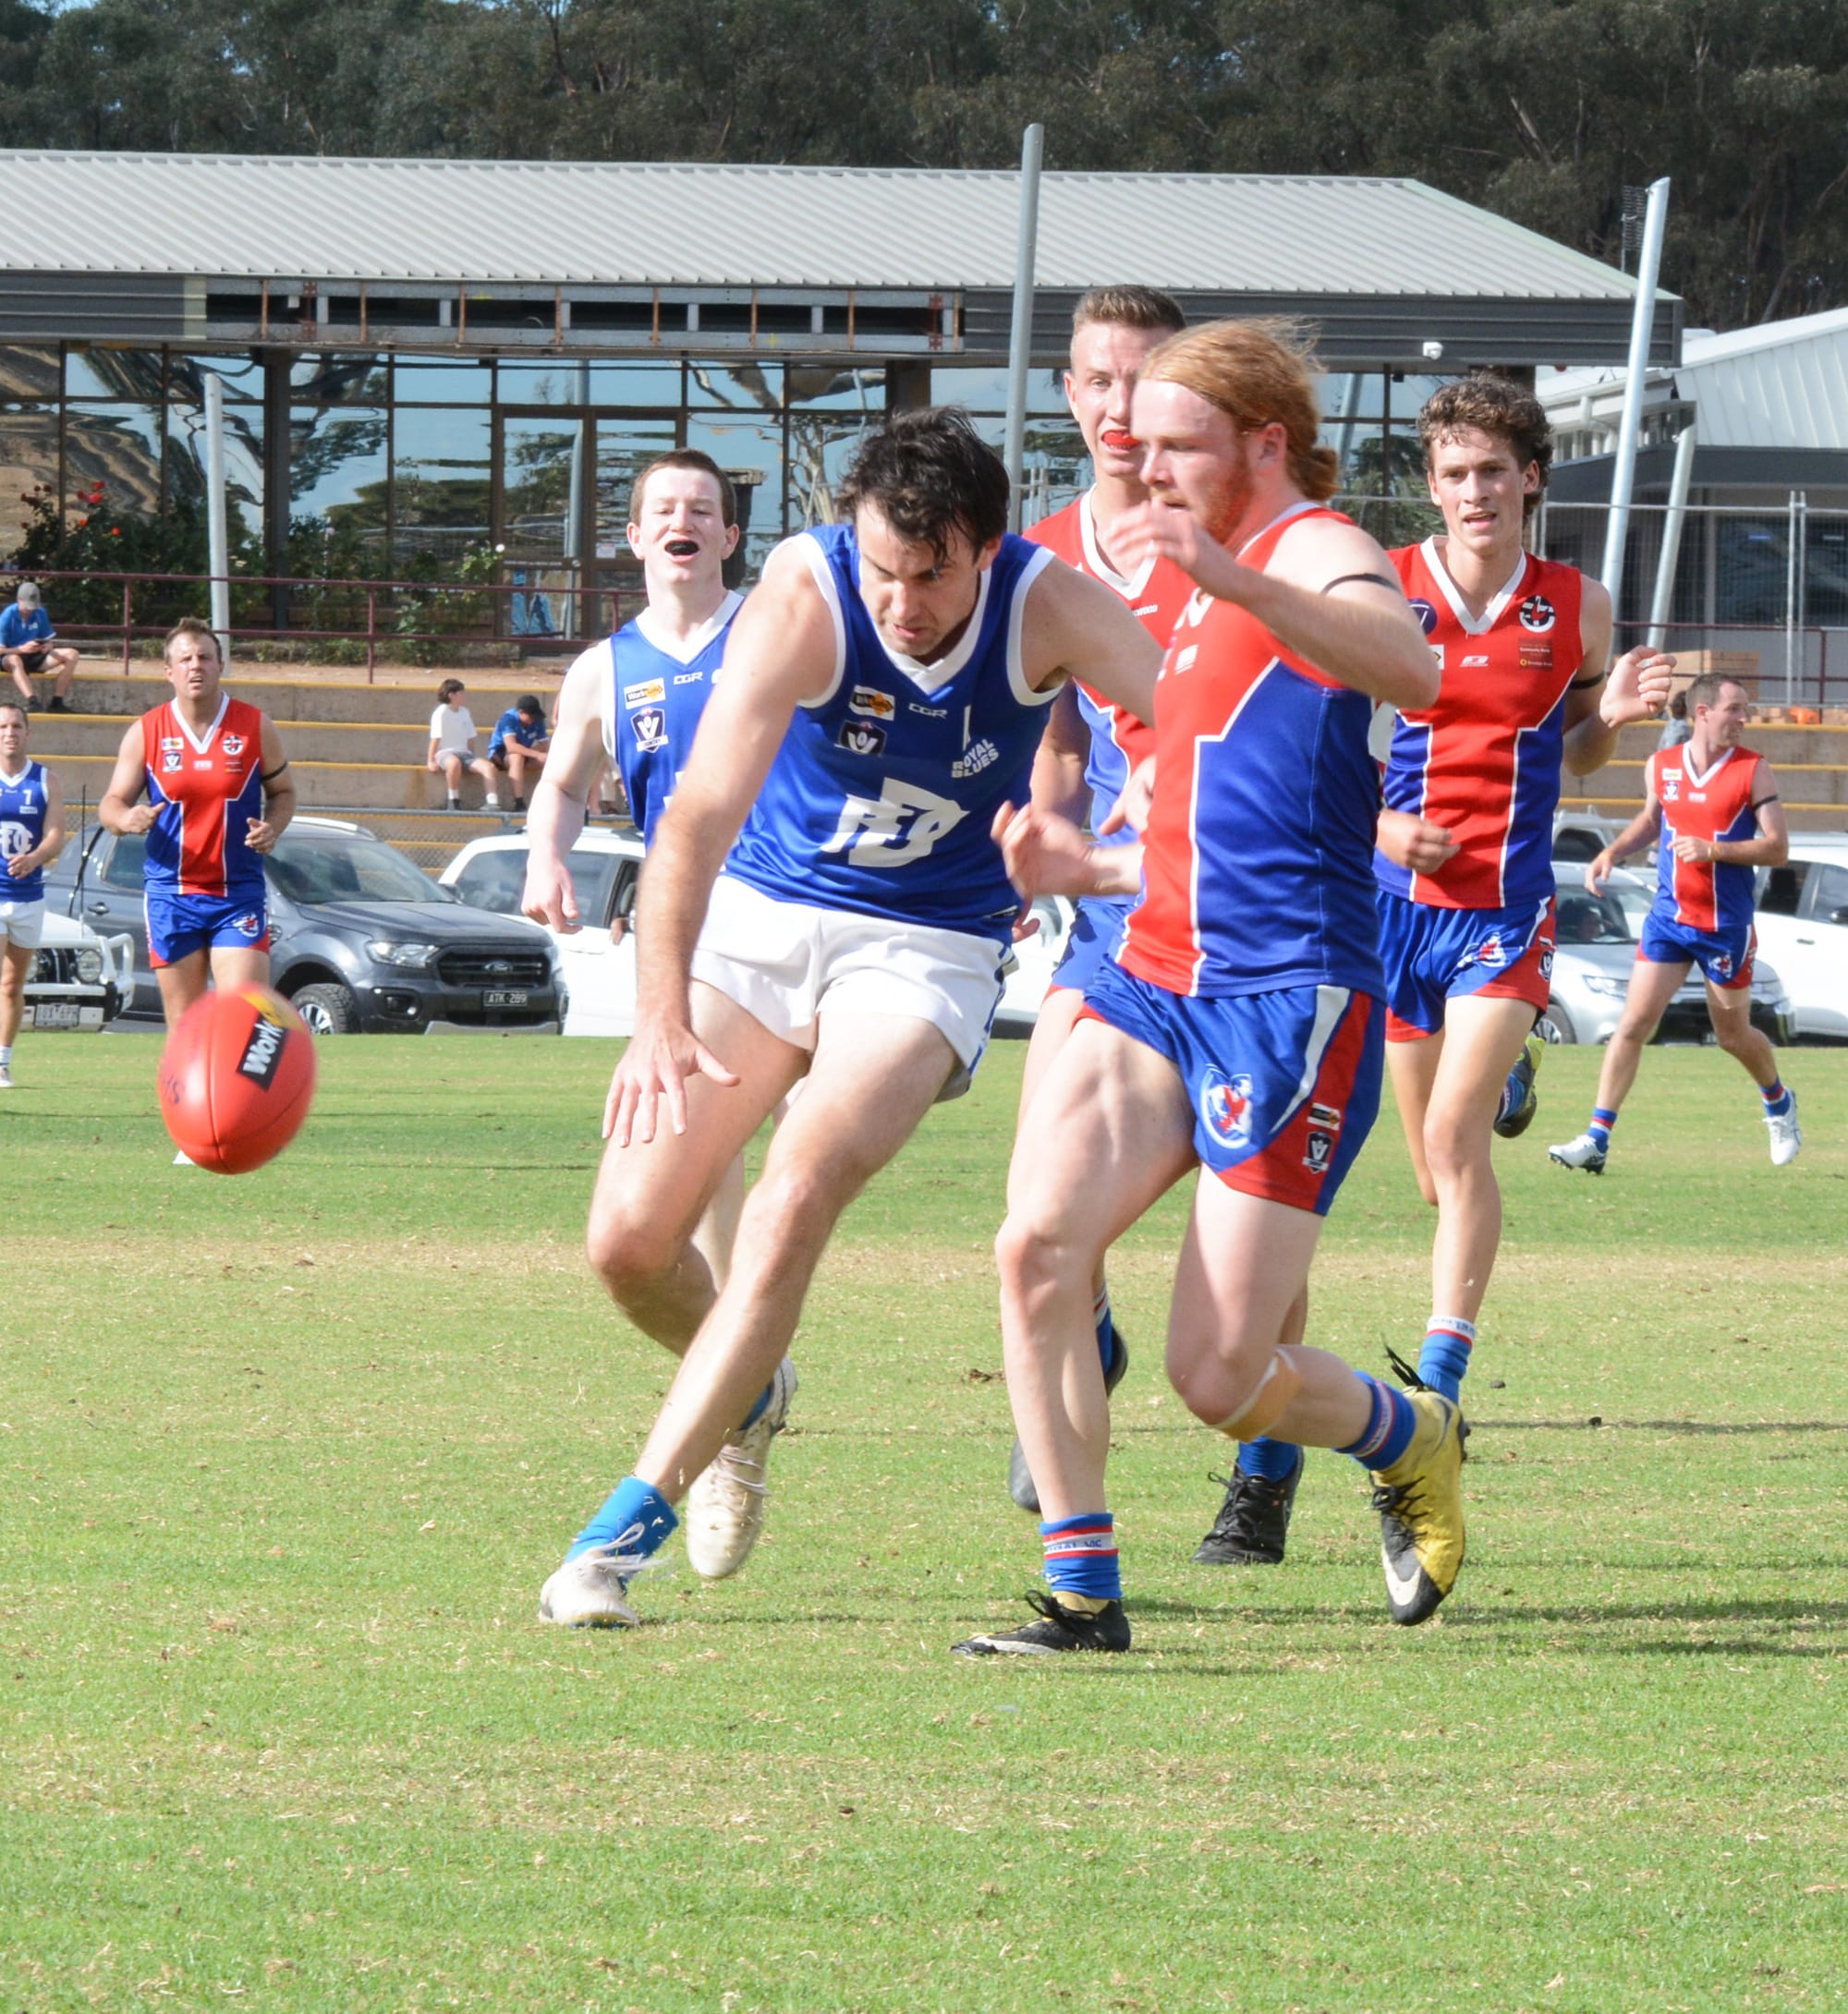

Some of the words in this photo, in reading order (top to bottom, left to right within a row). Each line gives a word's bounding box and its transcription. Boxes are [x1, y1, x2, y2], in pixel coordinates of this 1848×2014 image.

[673, 671, 703, 685] CGR
[908, 702, 948, 720] CGR
[951, 747, 1000, 779] BLUES
[952, 738, 995, 770] ROYAL
